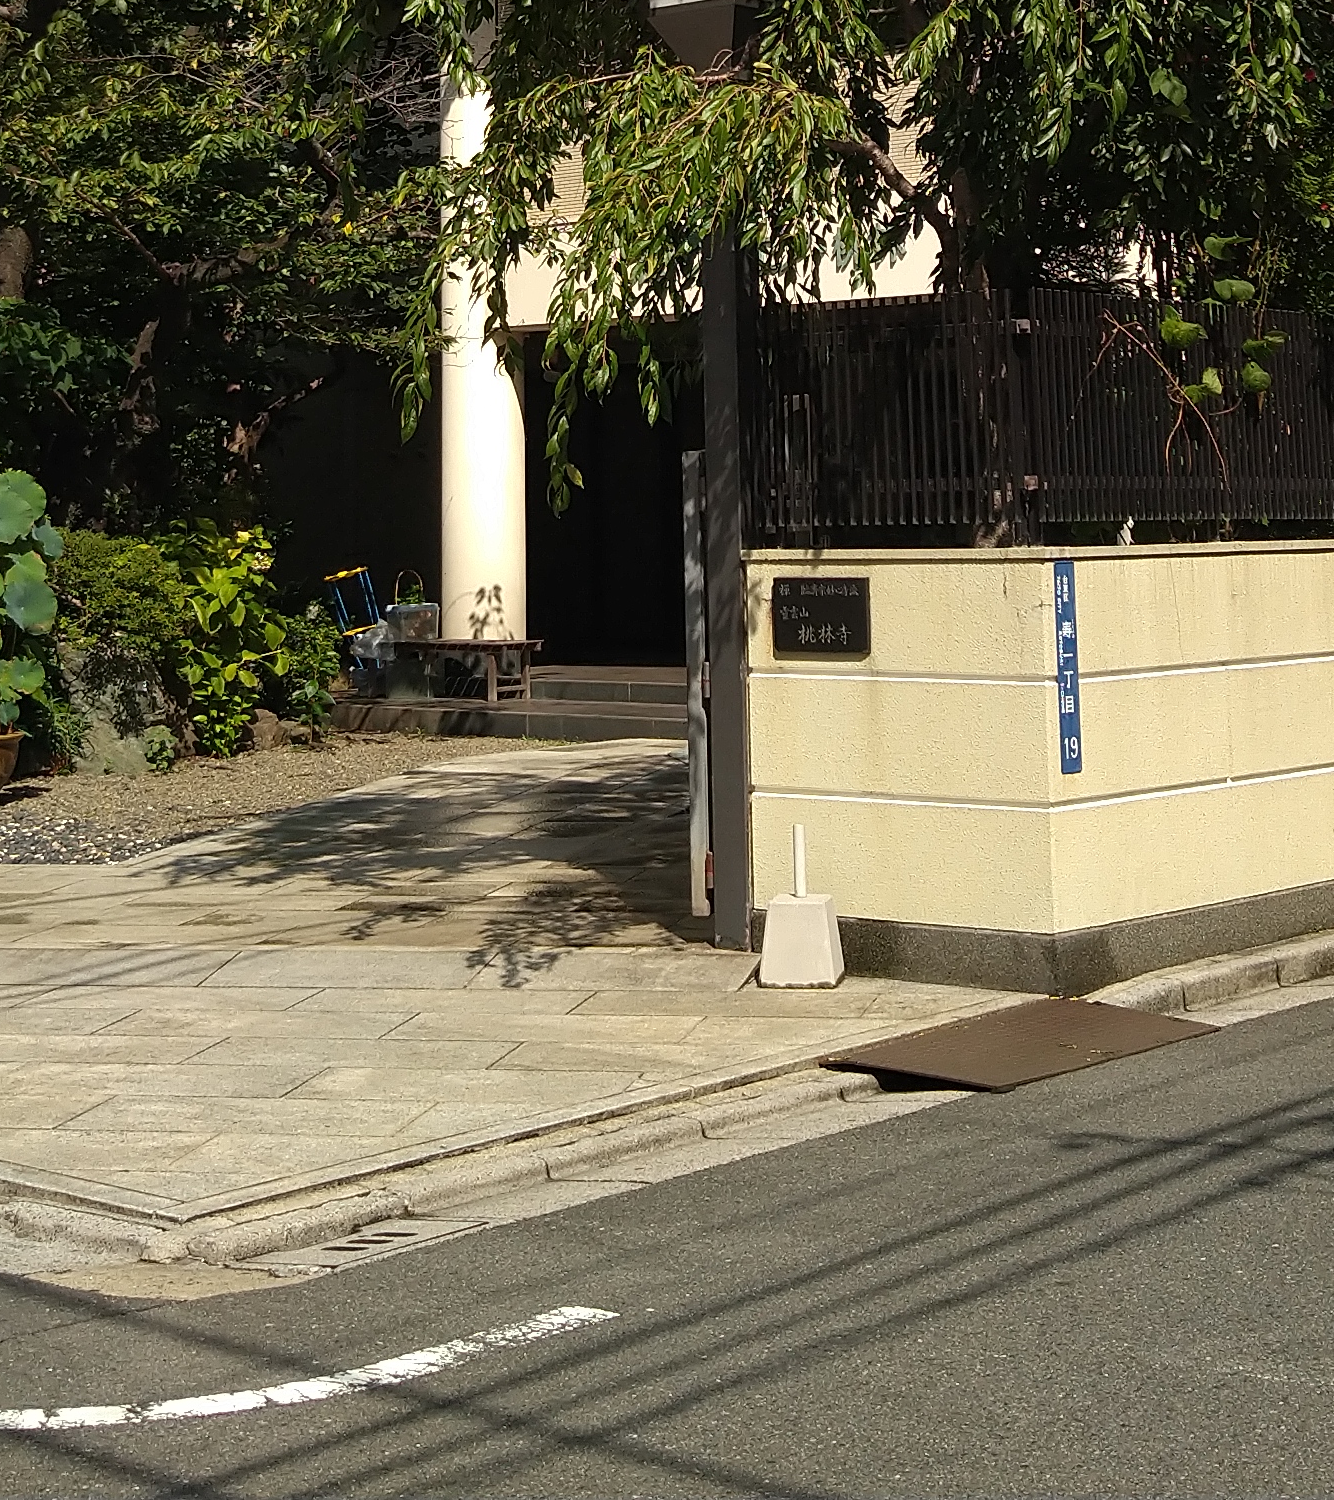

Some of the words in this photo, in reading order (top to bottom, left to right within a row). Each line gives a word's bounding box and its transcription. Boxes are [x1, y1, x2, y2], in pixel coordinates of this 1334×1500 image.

[798, 623, 851, 644] 桃林寺
[1064, 736, 1079, 760] 19
